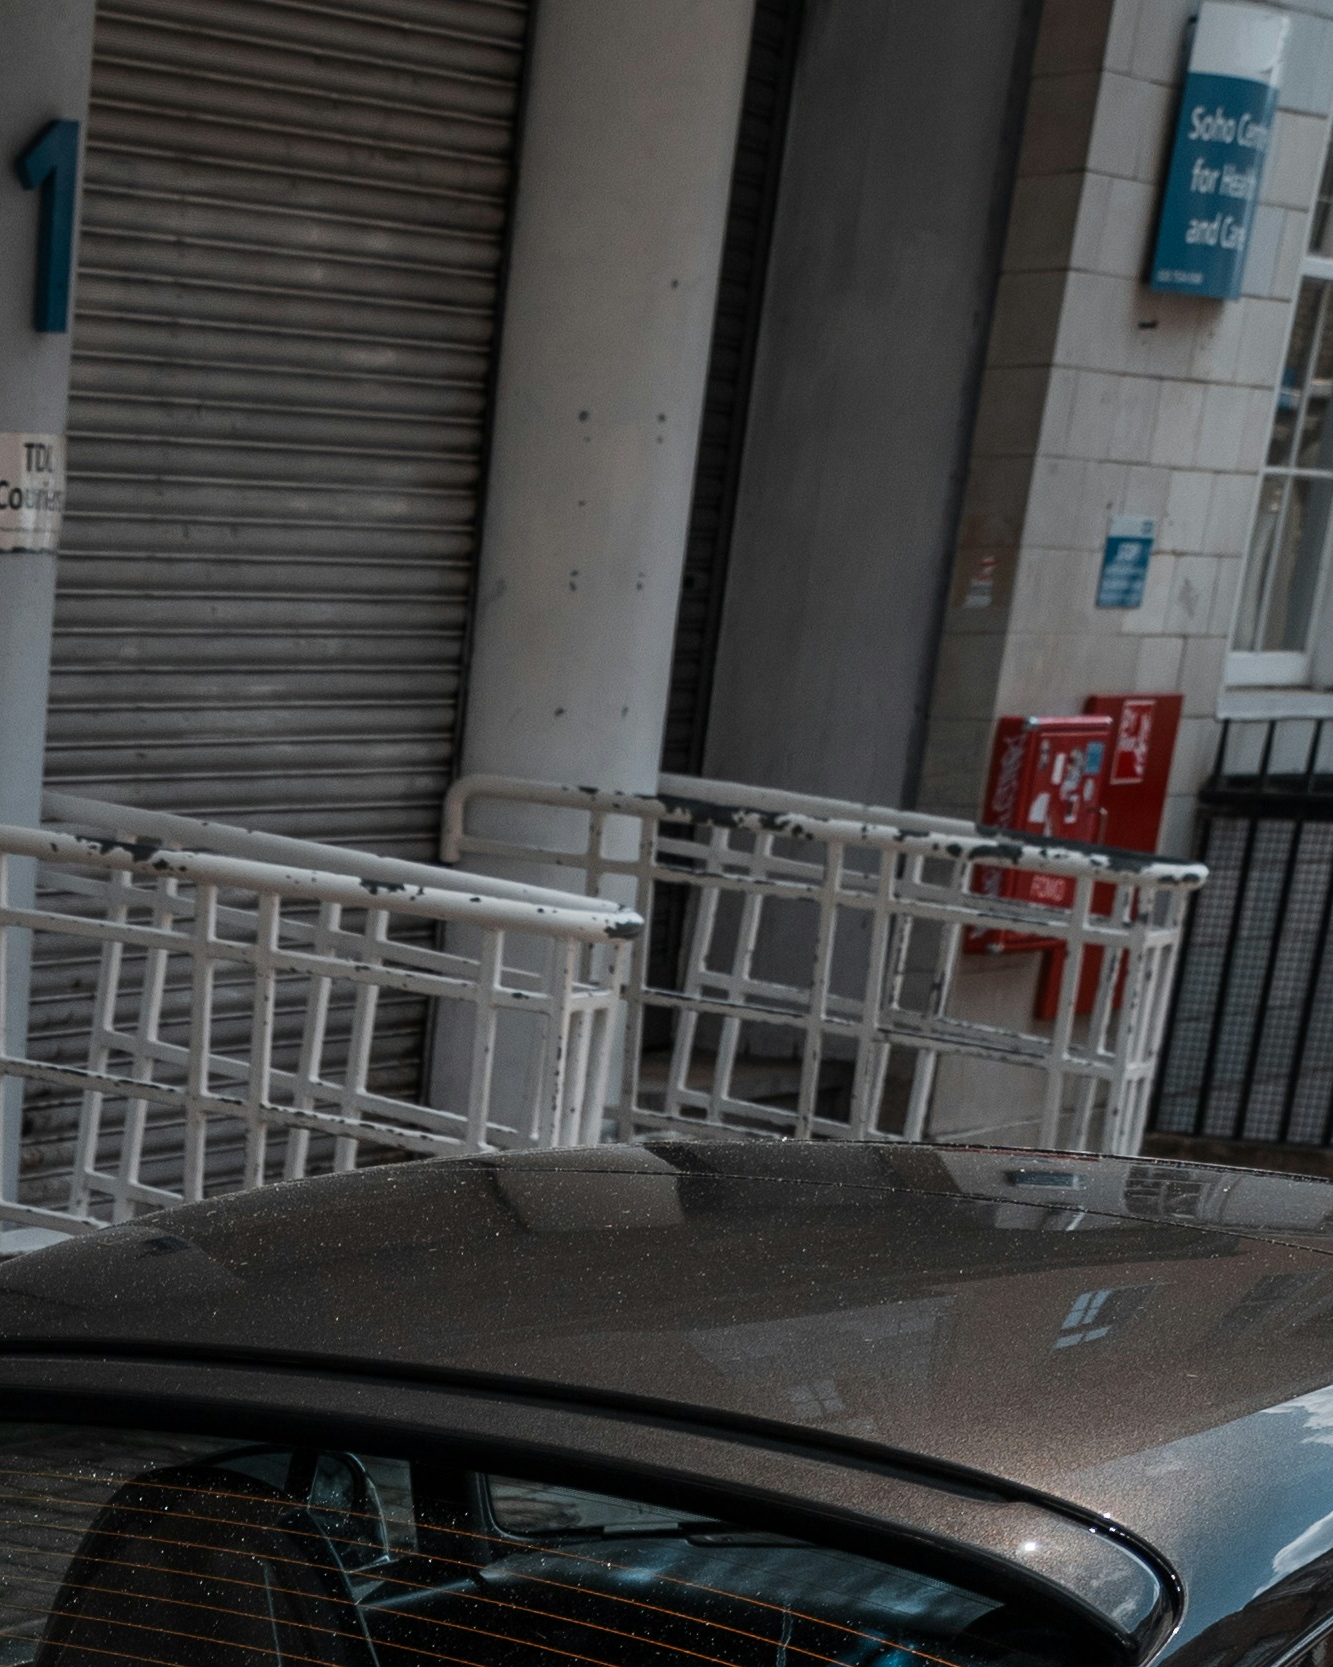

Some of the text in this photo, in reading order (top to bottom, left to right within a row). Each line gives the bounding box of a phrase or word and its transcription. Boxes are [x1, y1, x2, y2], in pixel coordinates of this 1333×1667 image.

[1188, 105, 1236, 144] Soho
[1190, 157, 1220, 194] for
[1185, 212, 1222, 247] and
